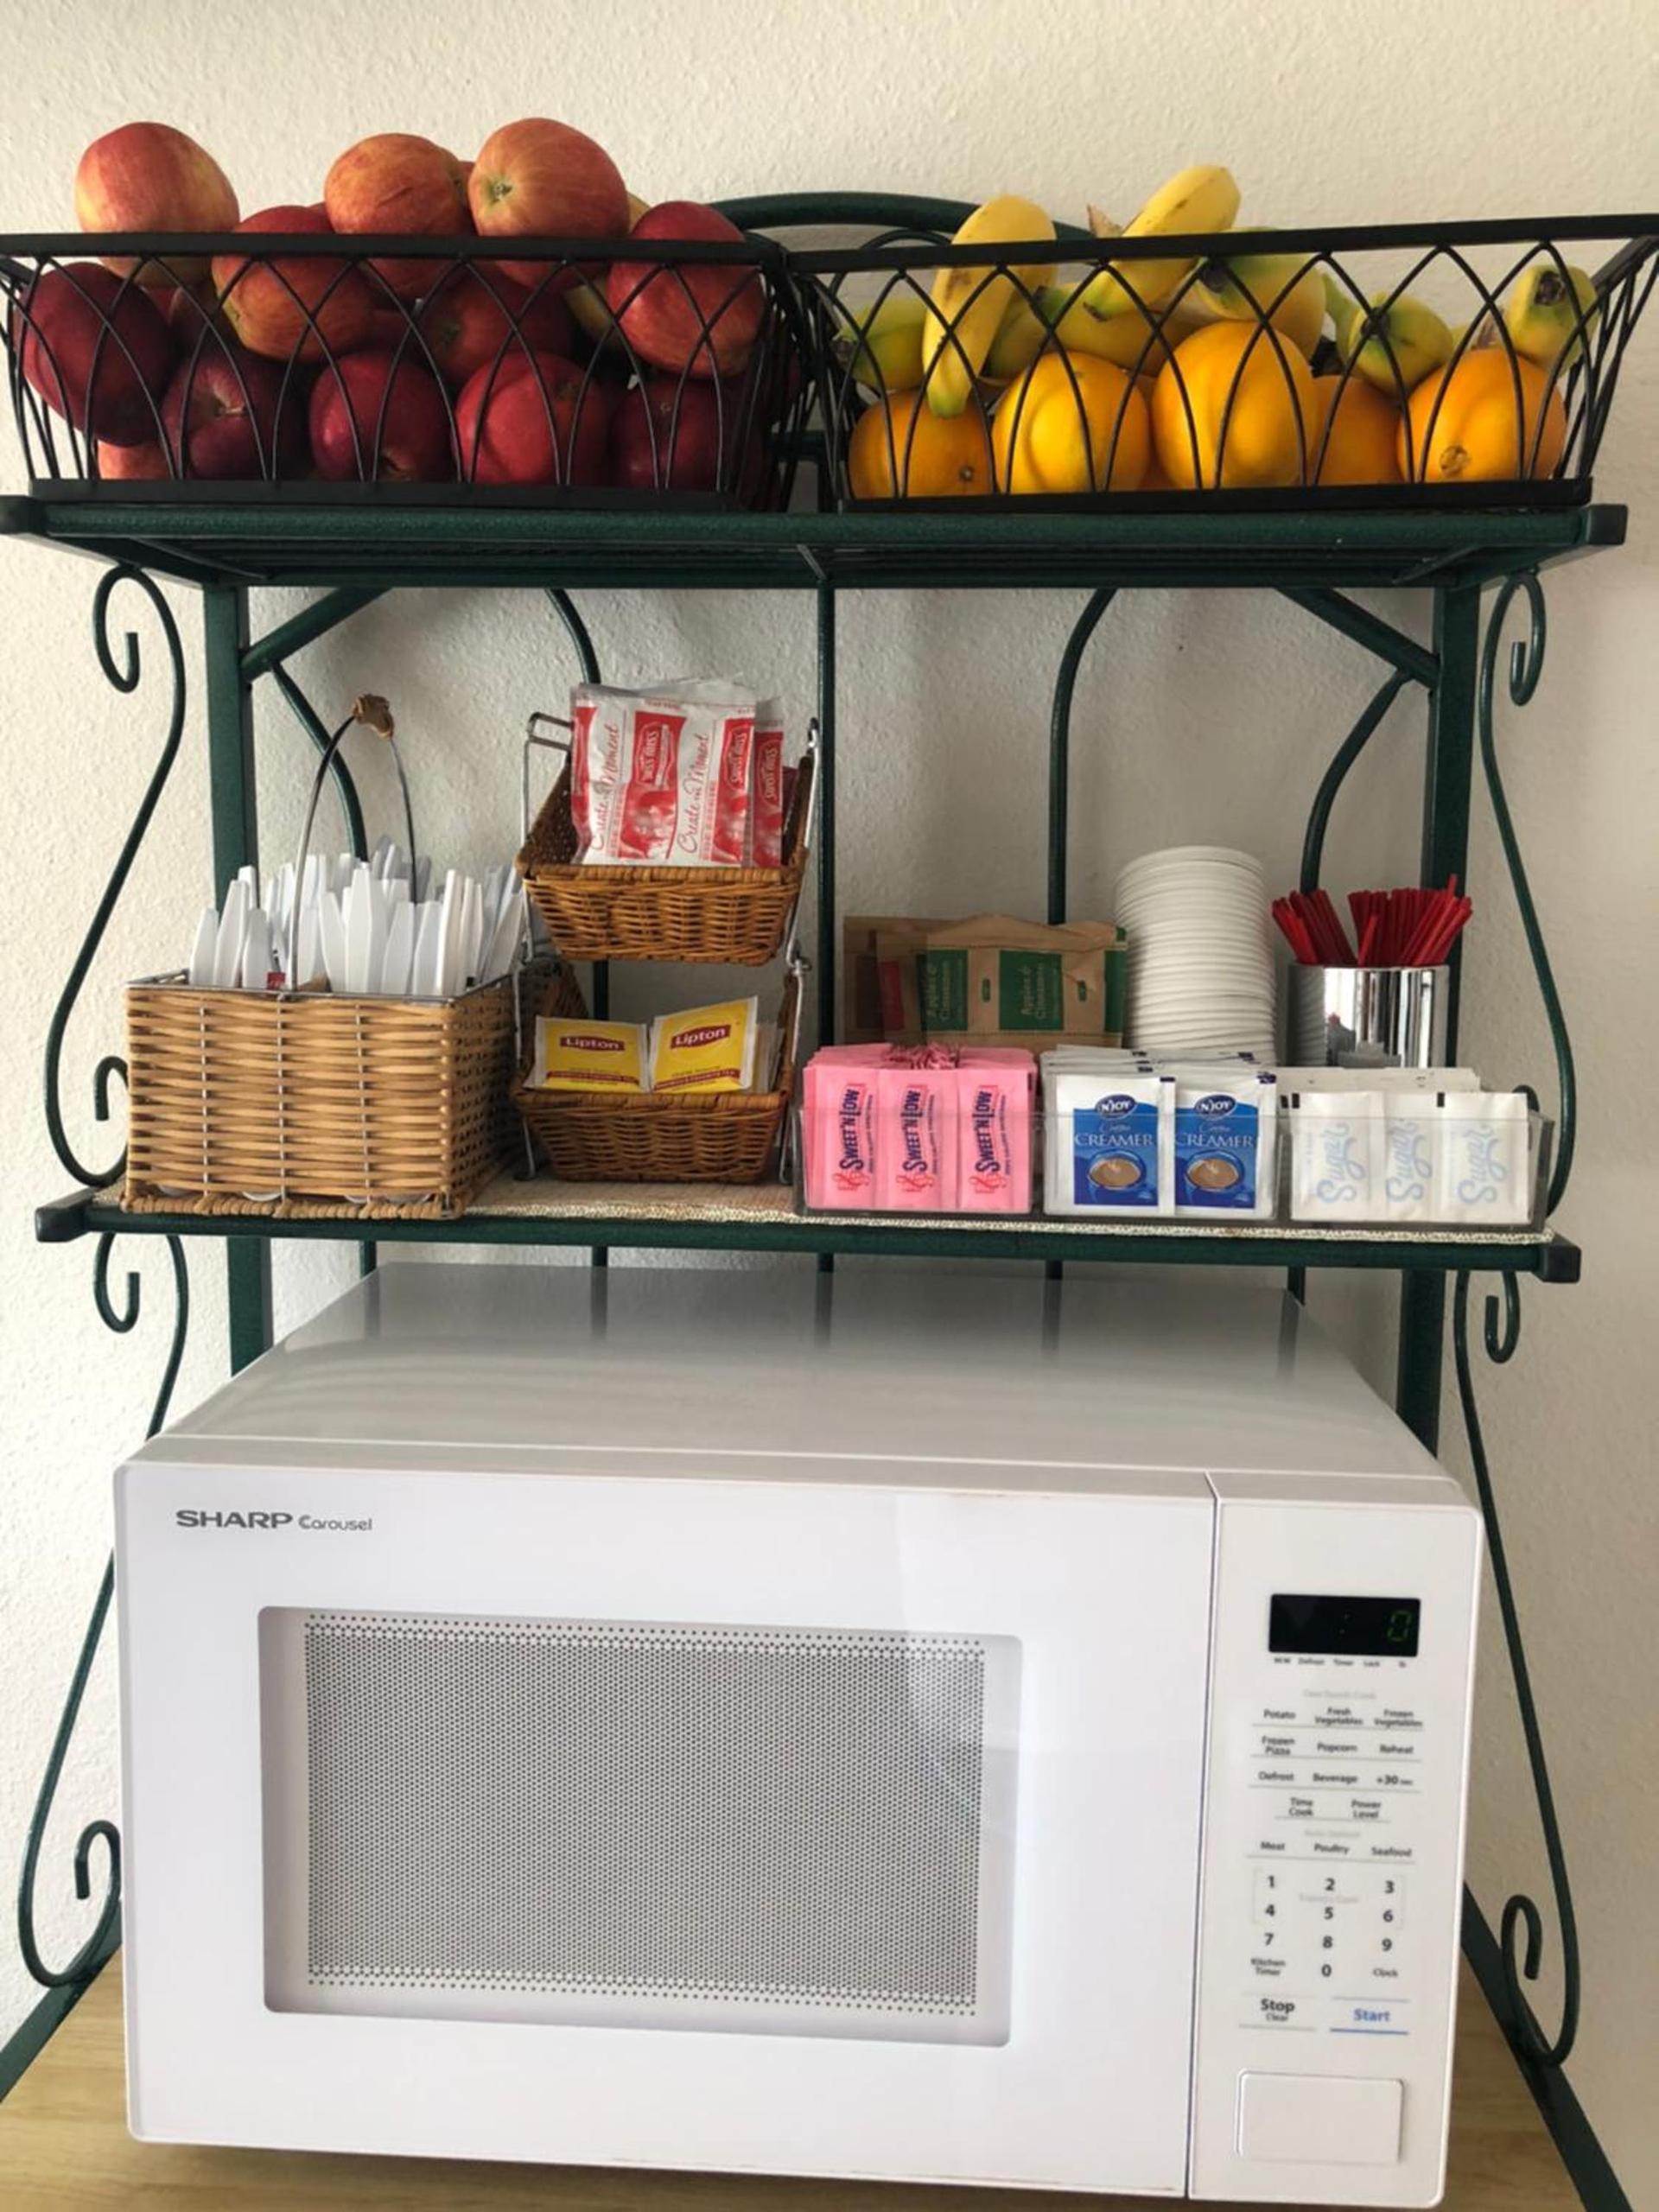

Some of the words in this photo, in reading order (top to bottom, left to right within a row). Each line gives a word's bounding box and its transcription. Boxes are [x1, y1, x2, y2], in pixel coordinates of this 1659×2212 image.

[565, 1037, 620, 1050] Lipton
[674, 1027, 727, 1047] Lipton
[1074, 1132, 1154, 1147] CREAMER
[1174, 1132, 1253, 1148] CREAMER
[1316, 1122, 1367, 1203] Sugar
[1386, 1122, 1433, 1202] Sugar
[1458, 1124, 1508, 1204] Sugar
[176, 1510, 294, 1529] SHARP
[298, 1514, 373, 1530] Carousel
[1263, 1709, 1296, 1719] Potato
[1327, 1707, 1351, 1716] Fresh
[1262, 1736, 1295, 1746] Frozen
[1265, 1745, 1291, 1756] Pizza
[1317, 1743, 1358, 1753] Popcorn
[1380, 1745, 1414, 1754] Reheat
[1258, 1771, 1294, 1782] Defrost
[1313, 1773, 1358, 1784] Beverage
[1290, 1797, 1313, 1807] Time
[1351, 1799, 1381, 1808] Power
[1288, 1807, 1313, 1816] Cook
[1353, 1809, 1379, 1819] Level
[1260, 1841, 1286, 1851] Meat
[1313, 1842, 1351, 1855] Poultry
[1371, 1846, 1413, 1857] Seafood
[1267, 1875, 1275, 1888] 1
[1325, 1878, 1335, 1891] 2
[1384, 1880, 1395, 1894] 3
[1264, 1904, 1275, 1917] 4
[1324, 1907, 1334, 1920] 5
[1382, 1910, 1393, 1923] 6
[1264, 1933, 1274, 1947] 7
[1322, 1936, 1332, 1949] 8
[1382, 1939, 1392, 1952] 9
[1321, 1964, 1332, 1978] 0
[1373, 1967, 1398, 1978] Clock
[1260, 1998, 1296, 2014] Stop
[1353, 2008, 1391, 2023] Start
